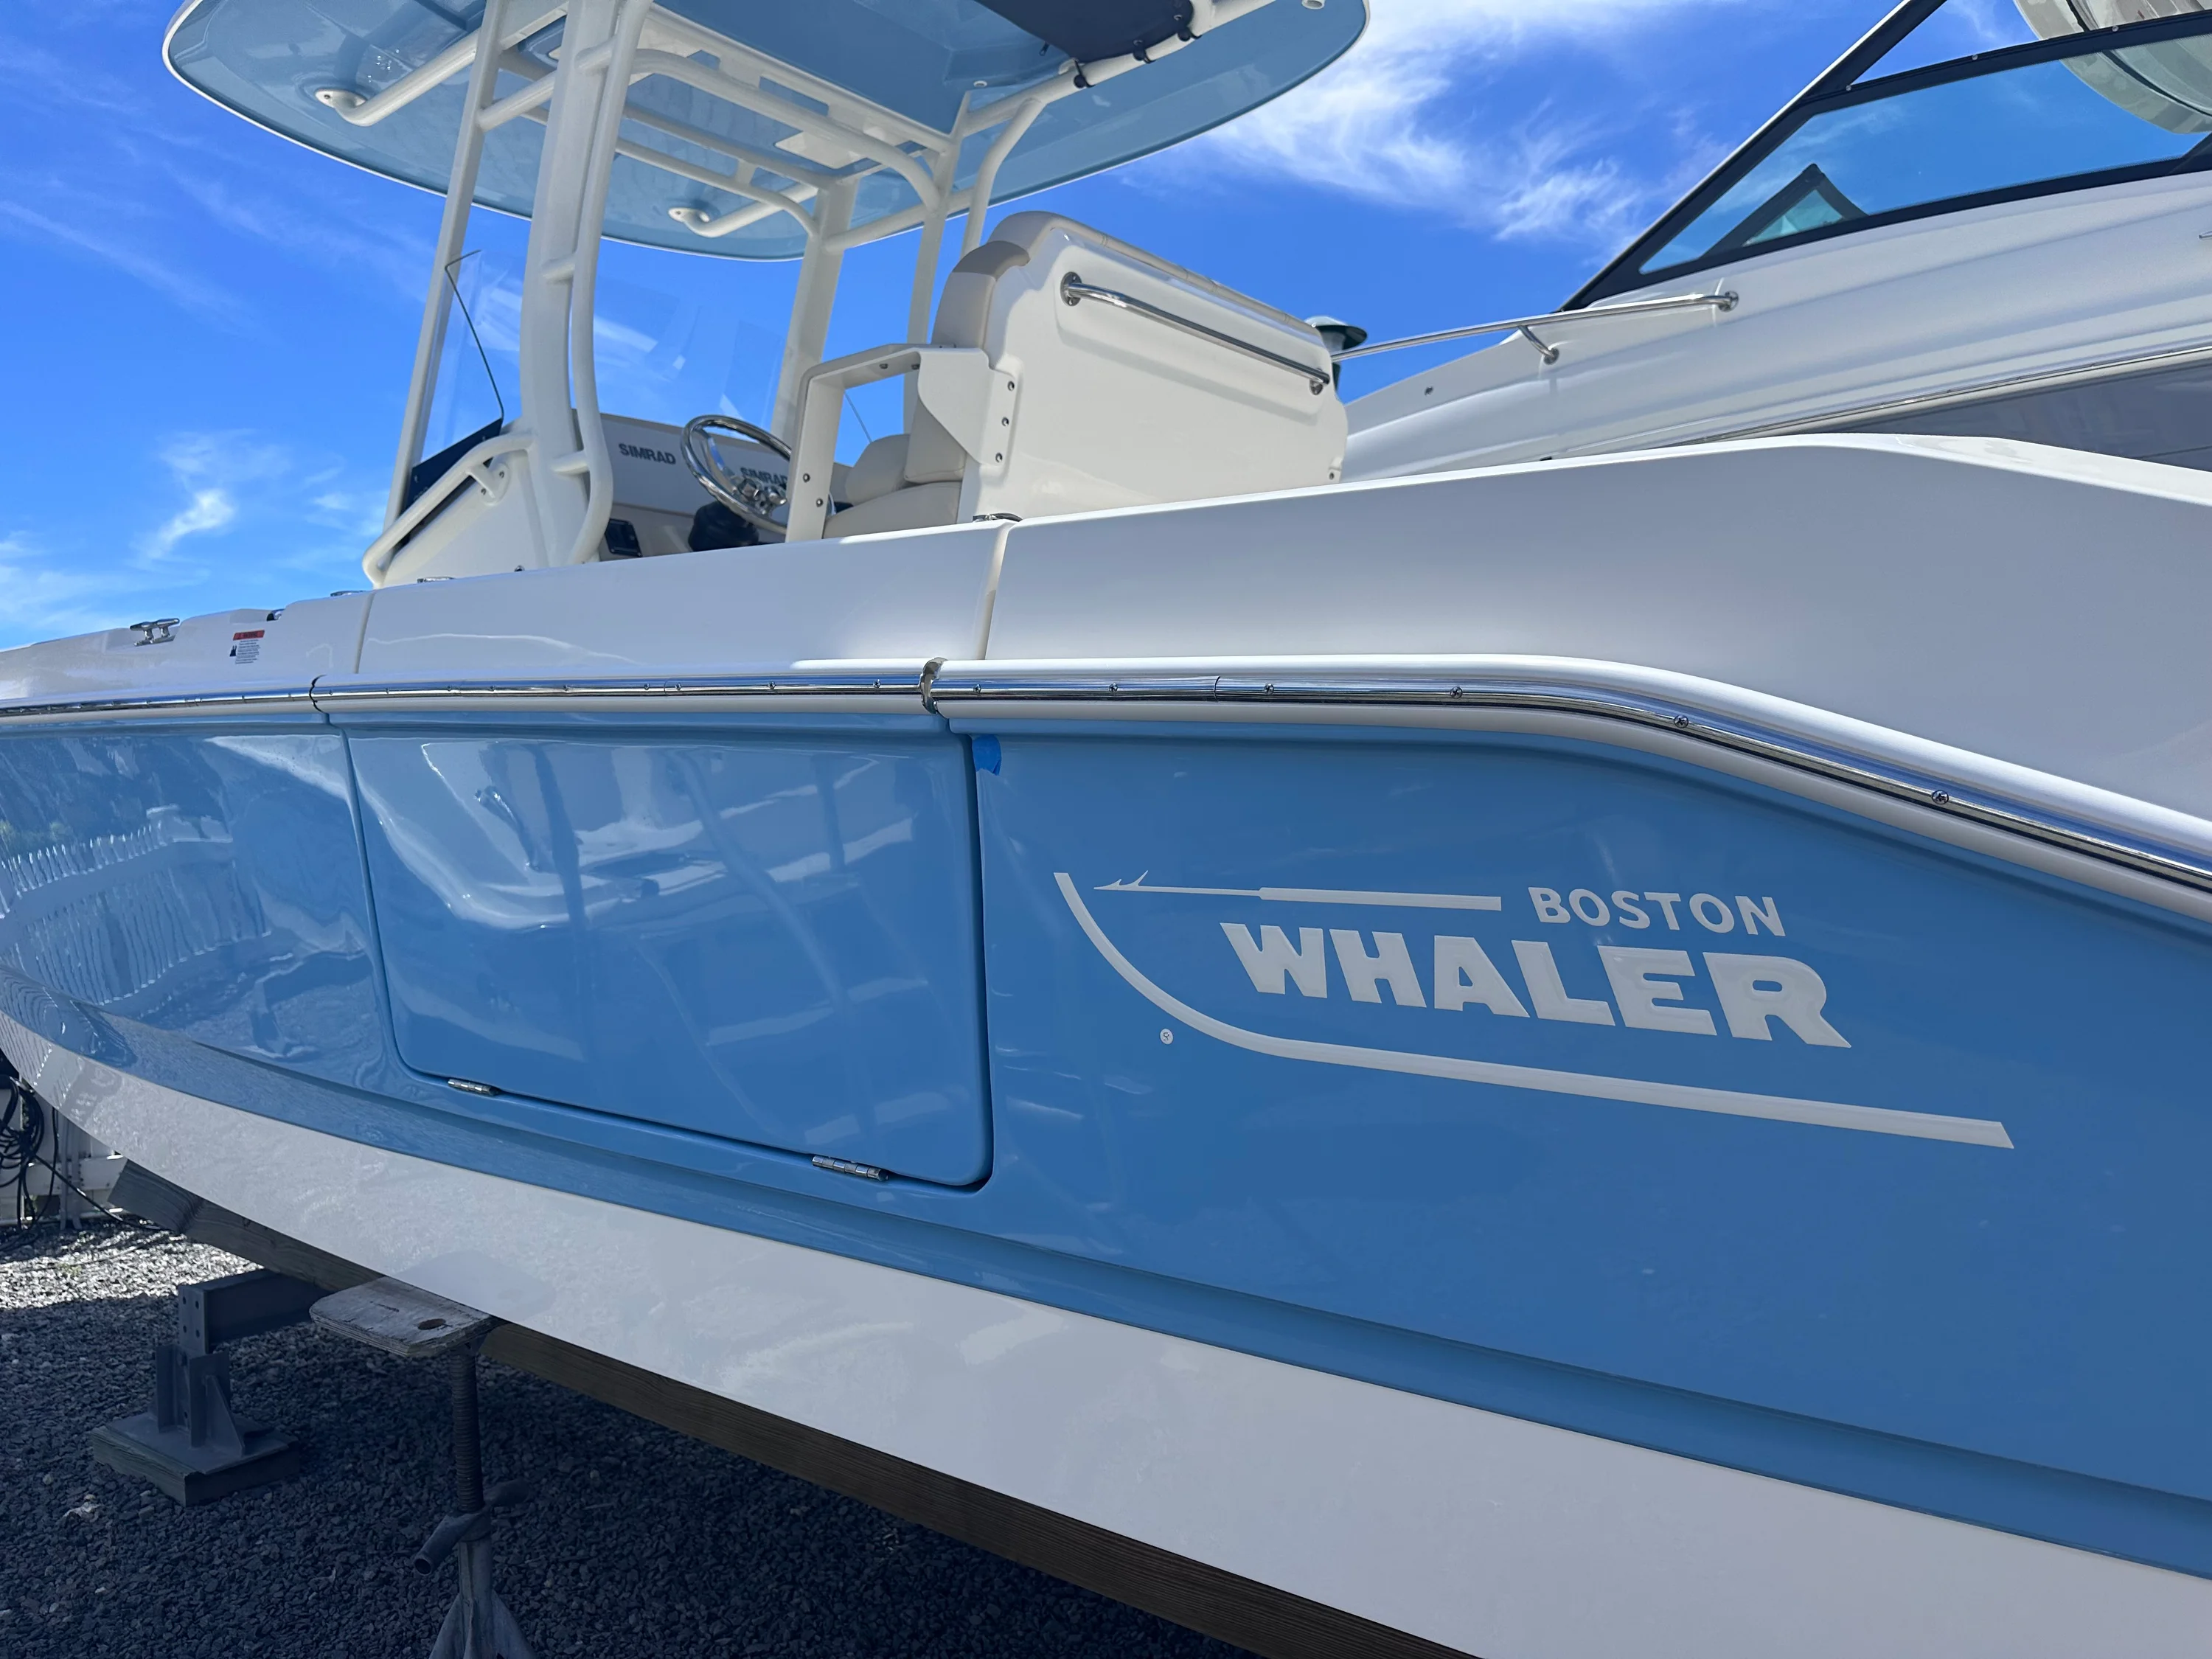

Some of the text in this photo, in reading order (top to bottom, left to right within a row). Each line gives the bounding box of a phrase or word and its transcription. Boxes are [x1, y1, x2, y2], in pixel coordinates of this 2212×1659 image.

[619, 443, 676, 465] SIMRAD
[1528, 887, 1785, 936] BOSTON
[1220, 922, 1851, 1048] WHALER
